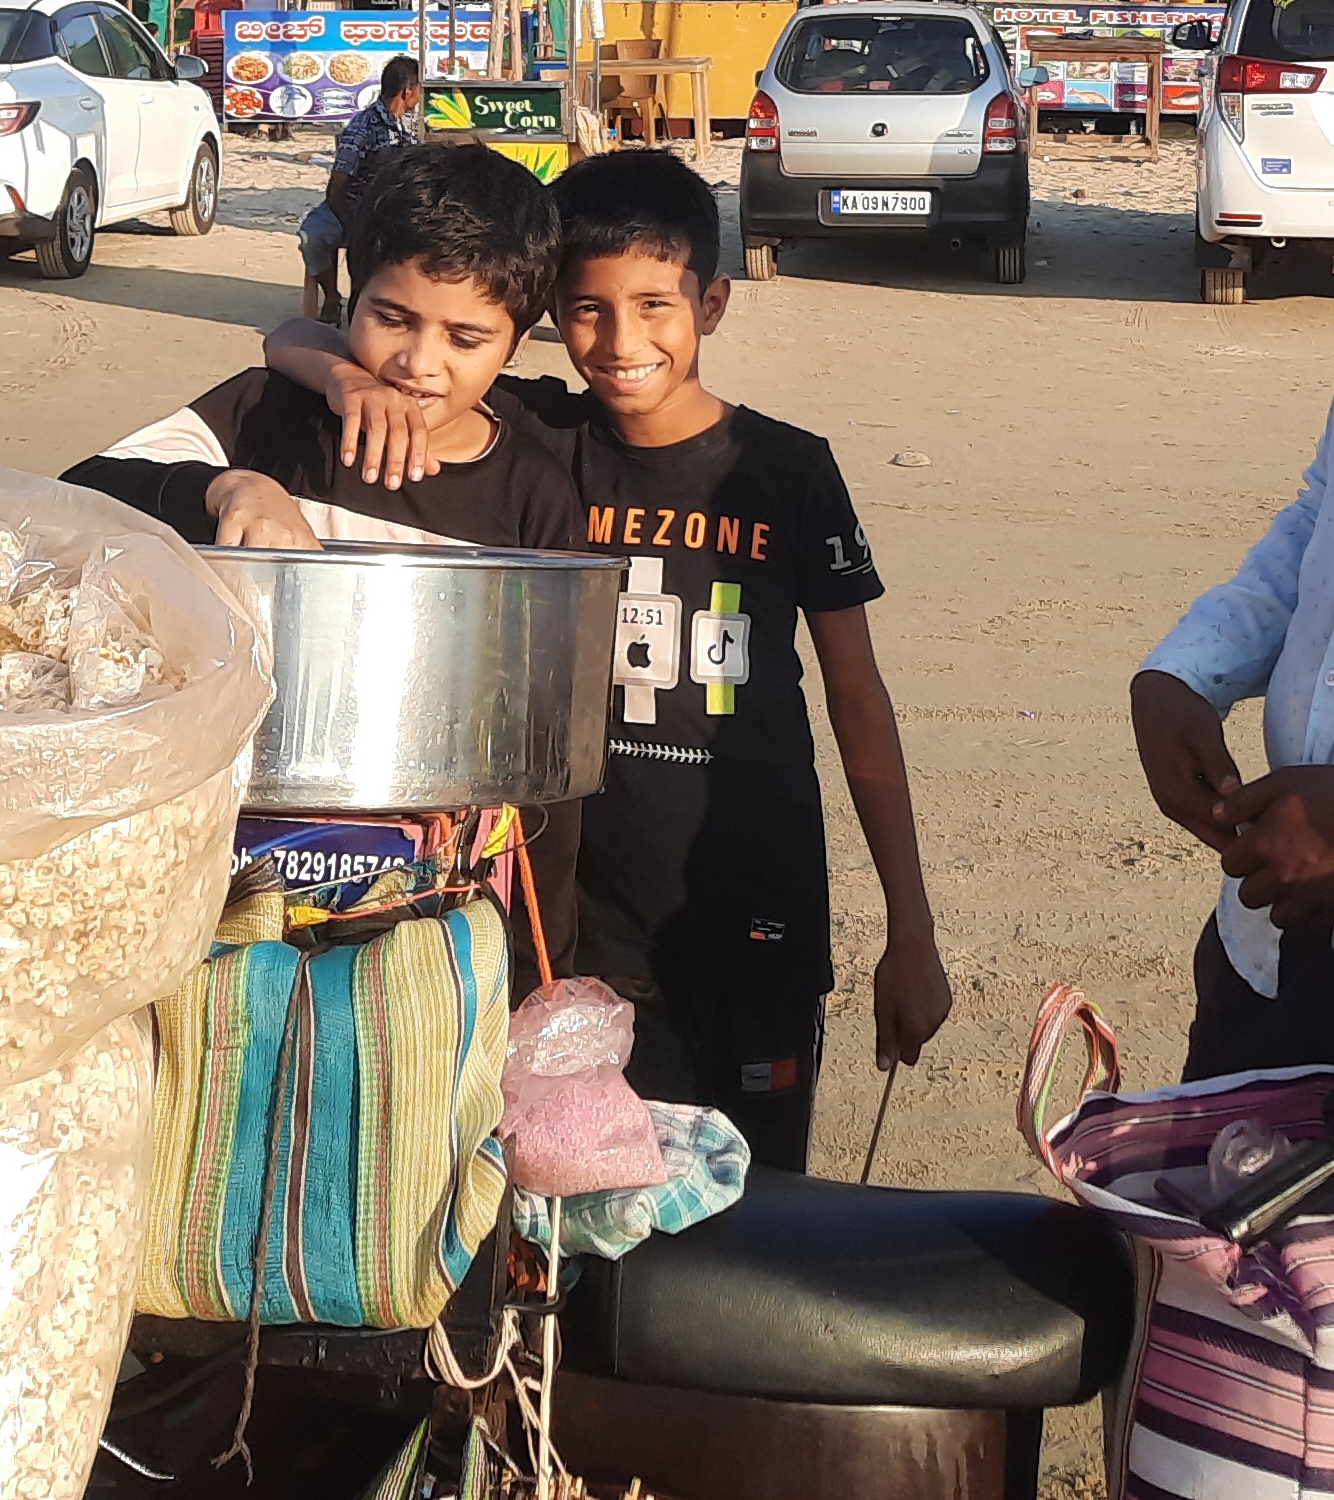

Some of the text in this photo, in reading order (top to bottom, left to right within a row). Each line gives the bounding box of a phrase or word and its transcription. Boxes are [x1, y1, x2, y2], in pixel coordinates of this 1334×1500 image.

[994, 8, 1226, 26] HOTEL FISHERMA
[235, 16, 325, 41] ಬೀಚ್
[474, 96, 534, 115] Sweet
[504, 111, 556, 129] Corn
[621, 607, 664, 626] 12:51
